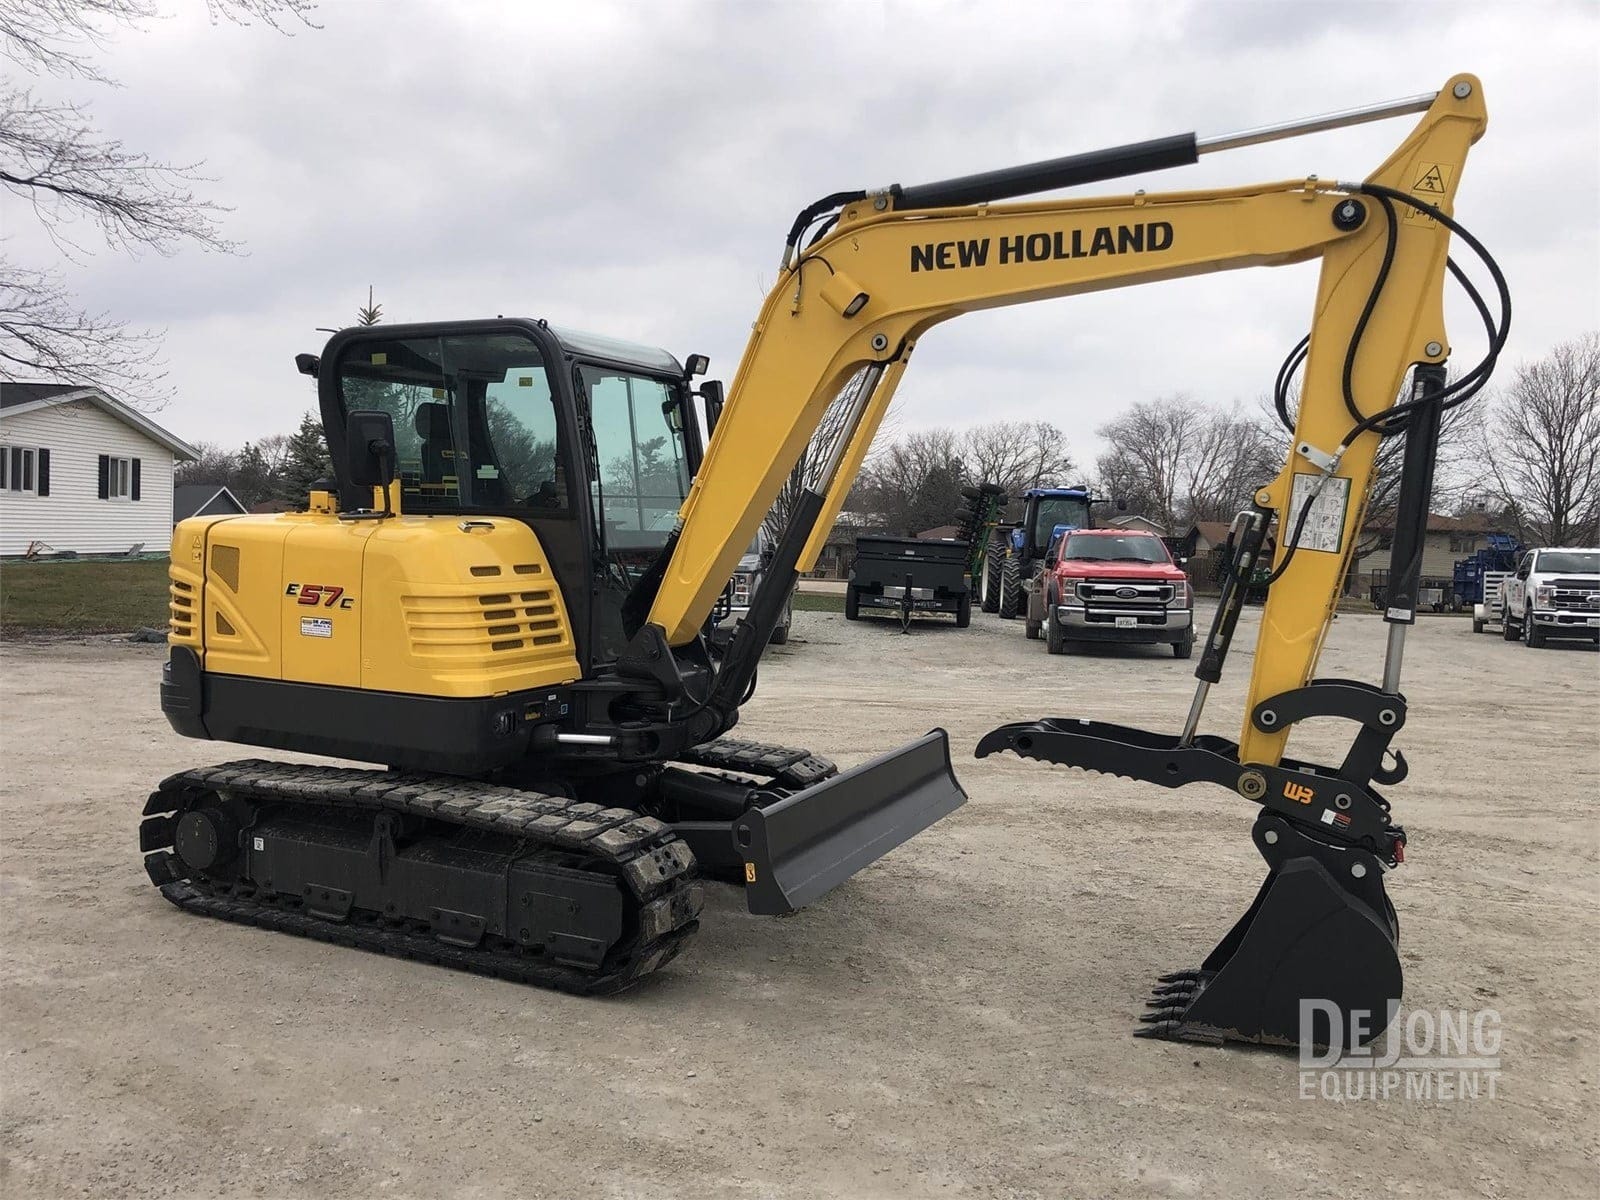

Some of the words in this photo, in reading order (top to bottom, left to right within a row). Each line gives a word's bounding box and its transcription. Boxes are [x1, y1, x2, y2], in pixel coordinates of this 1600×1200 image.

[911, 239, 990, 272] NEW
[999, 221, 1174, 264] HOLLAND
[285, 583, 354, 608] E57C
